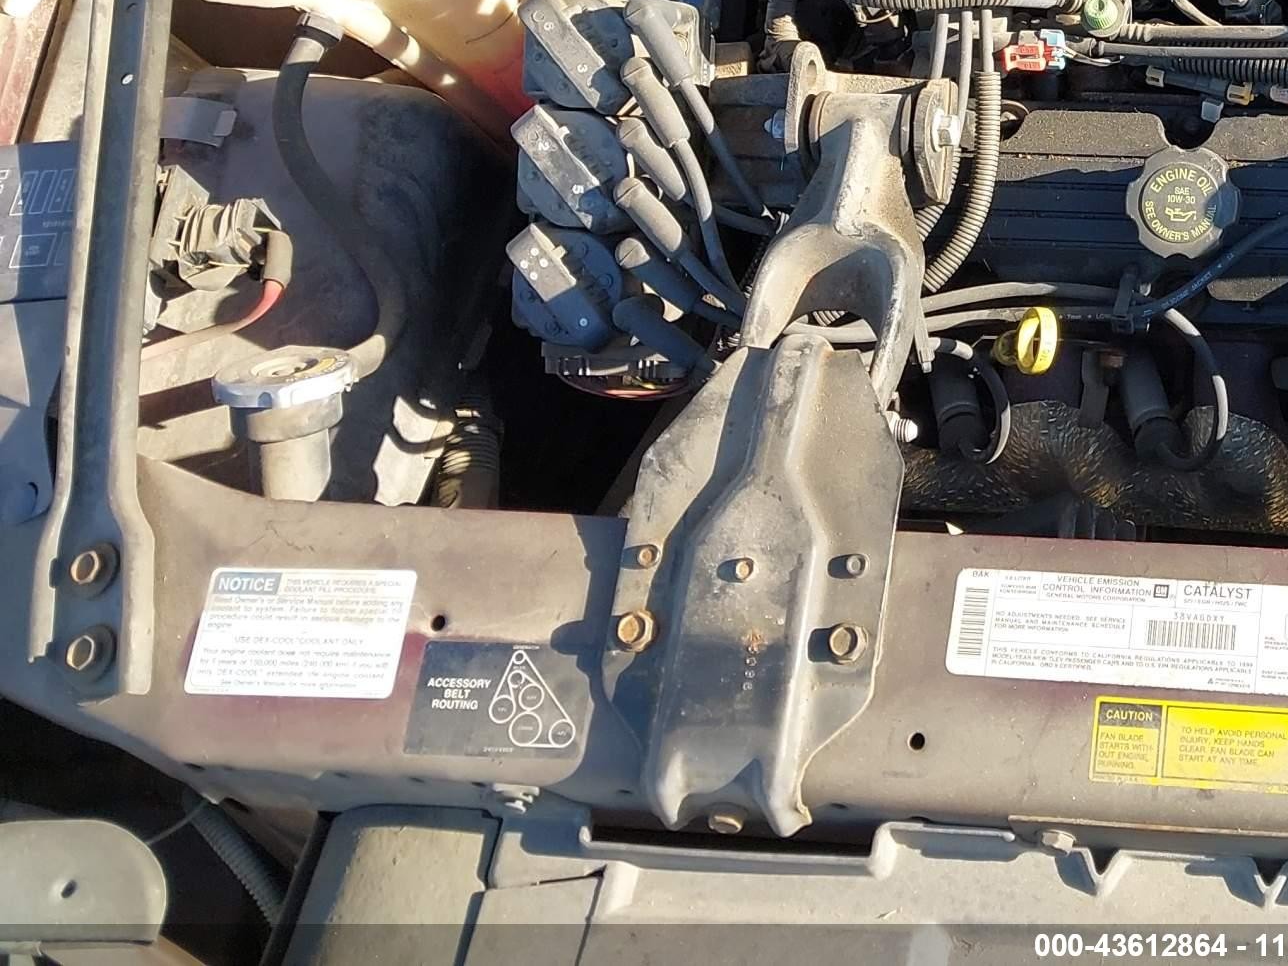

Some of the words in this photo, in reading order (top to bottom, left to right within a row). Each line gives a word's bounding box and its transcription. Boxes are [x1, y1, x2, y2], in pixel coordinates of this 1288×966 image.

[576, 62, 588, 73] 3
[1150, 168, 1198, 193] ENGINE
[1196, 176, 1214, 197] OIL
[571, 183, 584, 195] 5
[1174, 186, 1190, 195] SAE
[1167, 195, 1196, 204] 10W-30
[1145, 200, 1156, 220] SEE
[1151, 219, 1190, 241] OWNER'S
[1190, 204, 1217, 238] MANUAL
[218, 577, 276, 592] NOTICE
[1057, 575, 1094, 585] VEHICLE
[1097, 577, 1140, 587] EMISSION
[1042, 583, 1084, 593] CONTROL
[1090, 586, 1152, 597] INFORMATION
[1183, 584, 1252, 600] CATALYST
[427, 677, 491, 689] ACCESSORY
[443, 689, 471, 699] BELT
[431, 699, 479, 710] ROUTING
[1105, 709, 1153, 722] CAUTION
[1100, 732, 1116, 741] FAN
[1118, 733, 1144, 741] BLADE
[1181, 726, 1192, 734] TO
[1194, 727, 1215, 735] HELP
[1217, 728, 1242, 737] AVOID
[1244, 730, 1288, 740] PERSONAL
[1099, 741, 1130, 751] STARTS
[1213, 737, 1234, 746] KEEP
[1236, 739, 1265, 748] HANDS
[1099, 750, 1115, 759] OUT
[1210, 746, 1227, 755] FAN
[1229, 747, 1255, 756] BLADE
[1257, 749, 1275, 758] CAN
[1178, 754, 1205, 763] START
[1207, 755, 1218, 763] AT
[1219, 756, 1236, 764] ANY
